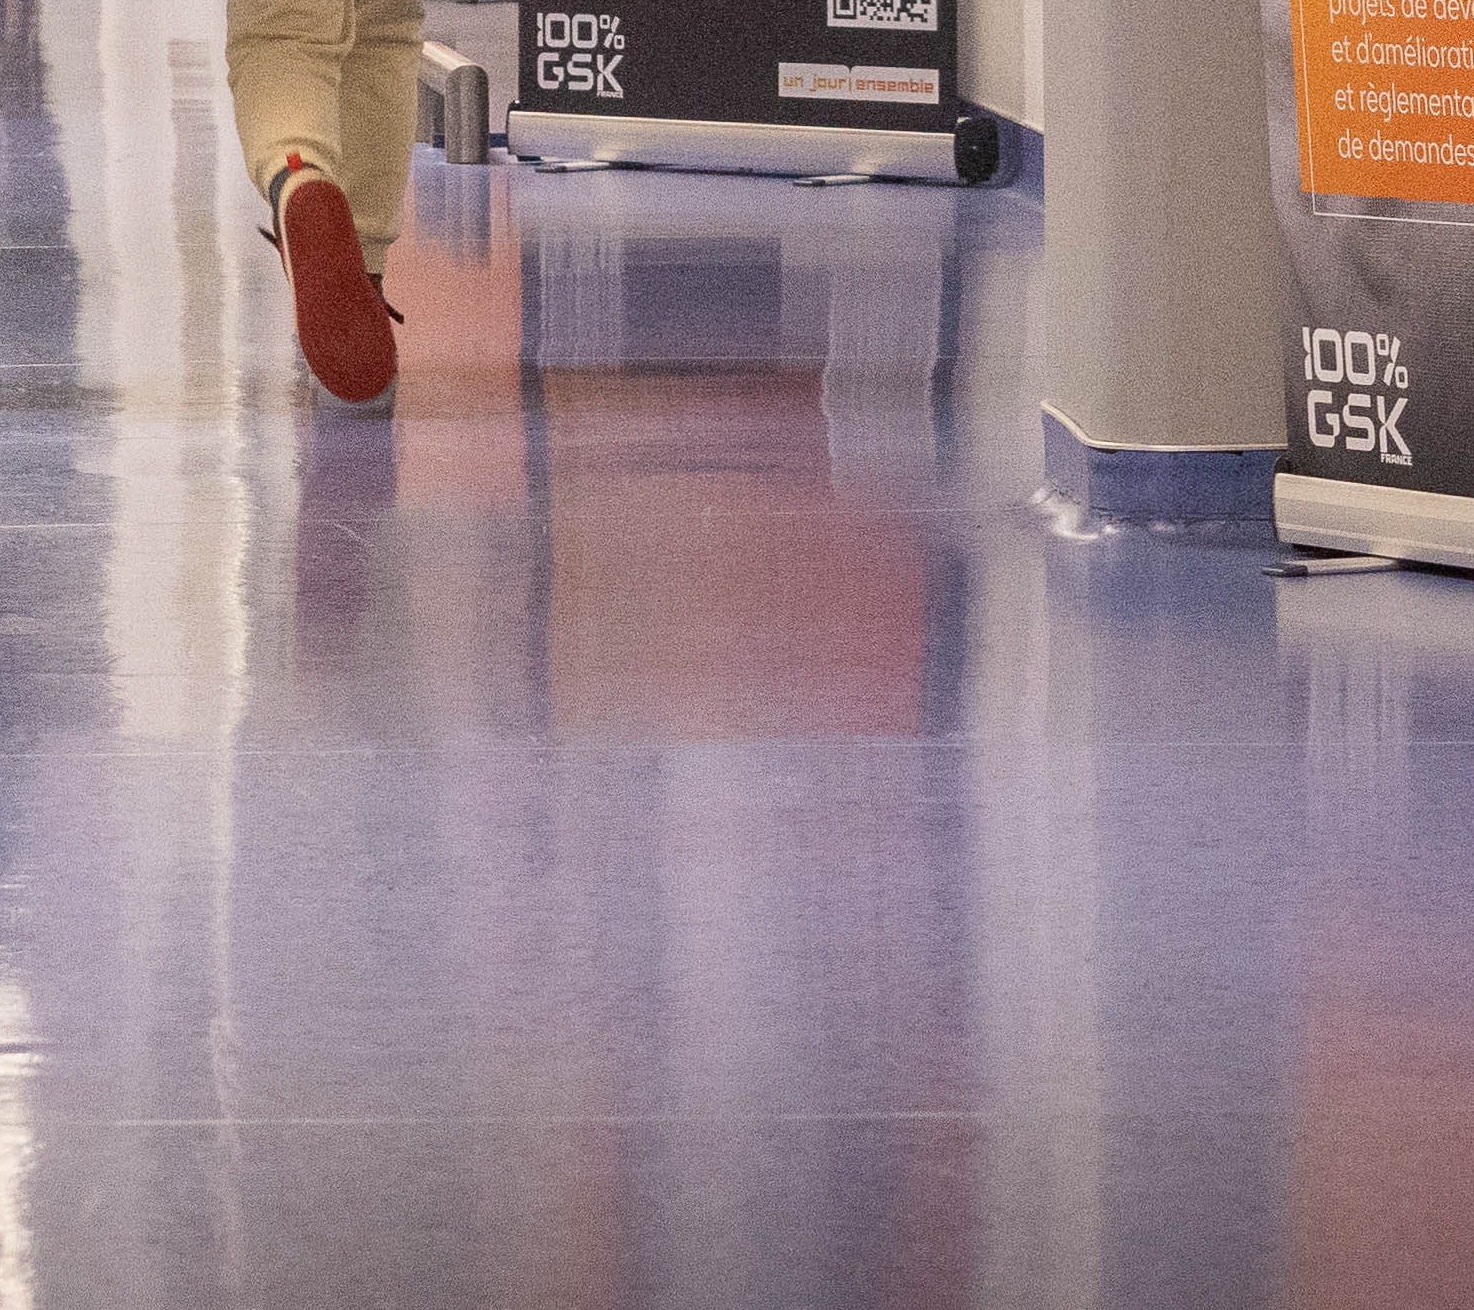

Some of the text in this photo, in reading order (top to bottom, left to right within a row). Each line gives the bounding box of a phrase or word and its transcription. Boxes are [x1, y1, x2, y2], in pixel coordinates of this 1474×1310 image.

[537, 13, 625, 49] 100%
[1332, 36, 1352, 62] et
[537, 52, 623, 91] GSK
[1335, 85, 1355, 111] et
[1338, 129, 1364, 158] de
[1303, 327, 1408, 388] 100%
[1308, 390, 1412, 454] GSK
[1380, 453, 1413, 466] FRANCE
